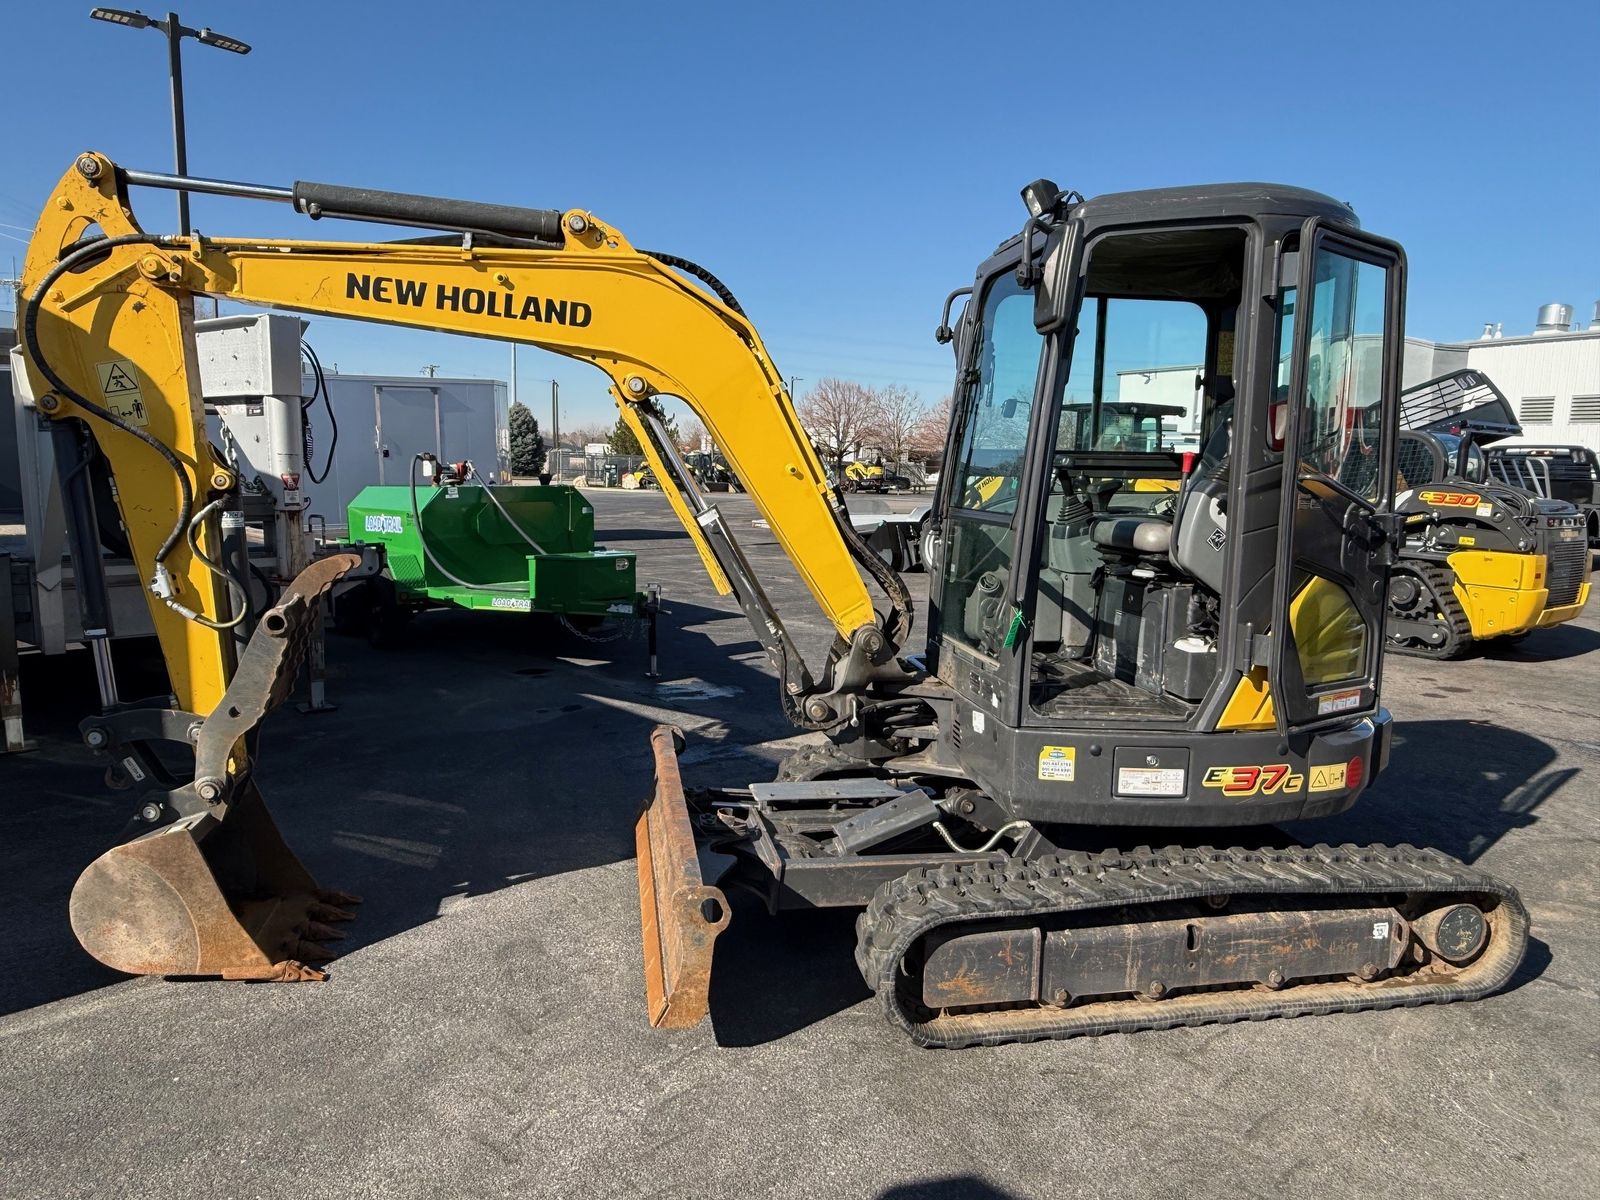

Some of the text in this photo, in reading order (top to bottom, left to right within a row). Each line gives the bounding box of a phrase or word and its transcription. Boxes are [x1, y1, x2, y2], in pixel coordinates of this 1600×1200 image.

[346, 272, 592, 328] NEW HOLLAND
[1419, 491, 1481, 507] C330
[366, 515, 382, 532] LOAD
[384, 516, 403, 534] TRAIL
[492, 598, 512, 607] LOAD
[1202, 764, 1304, 796] E37C
